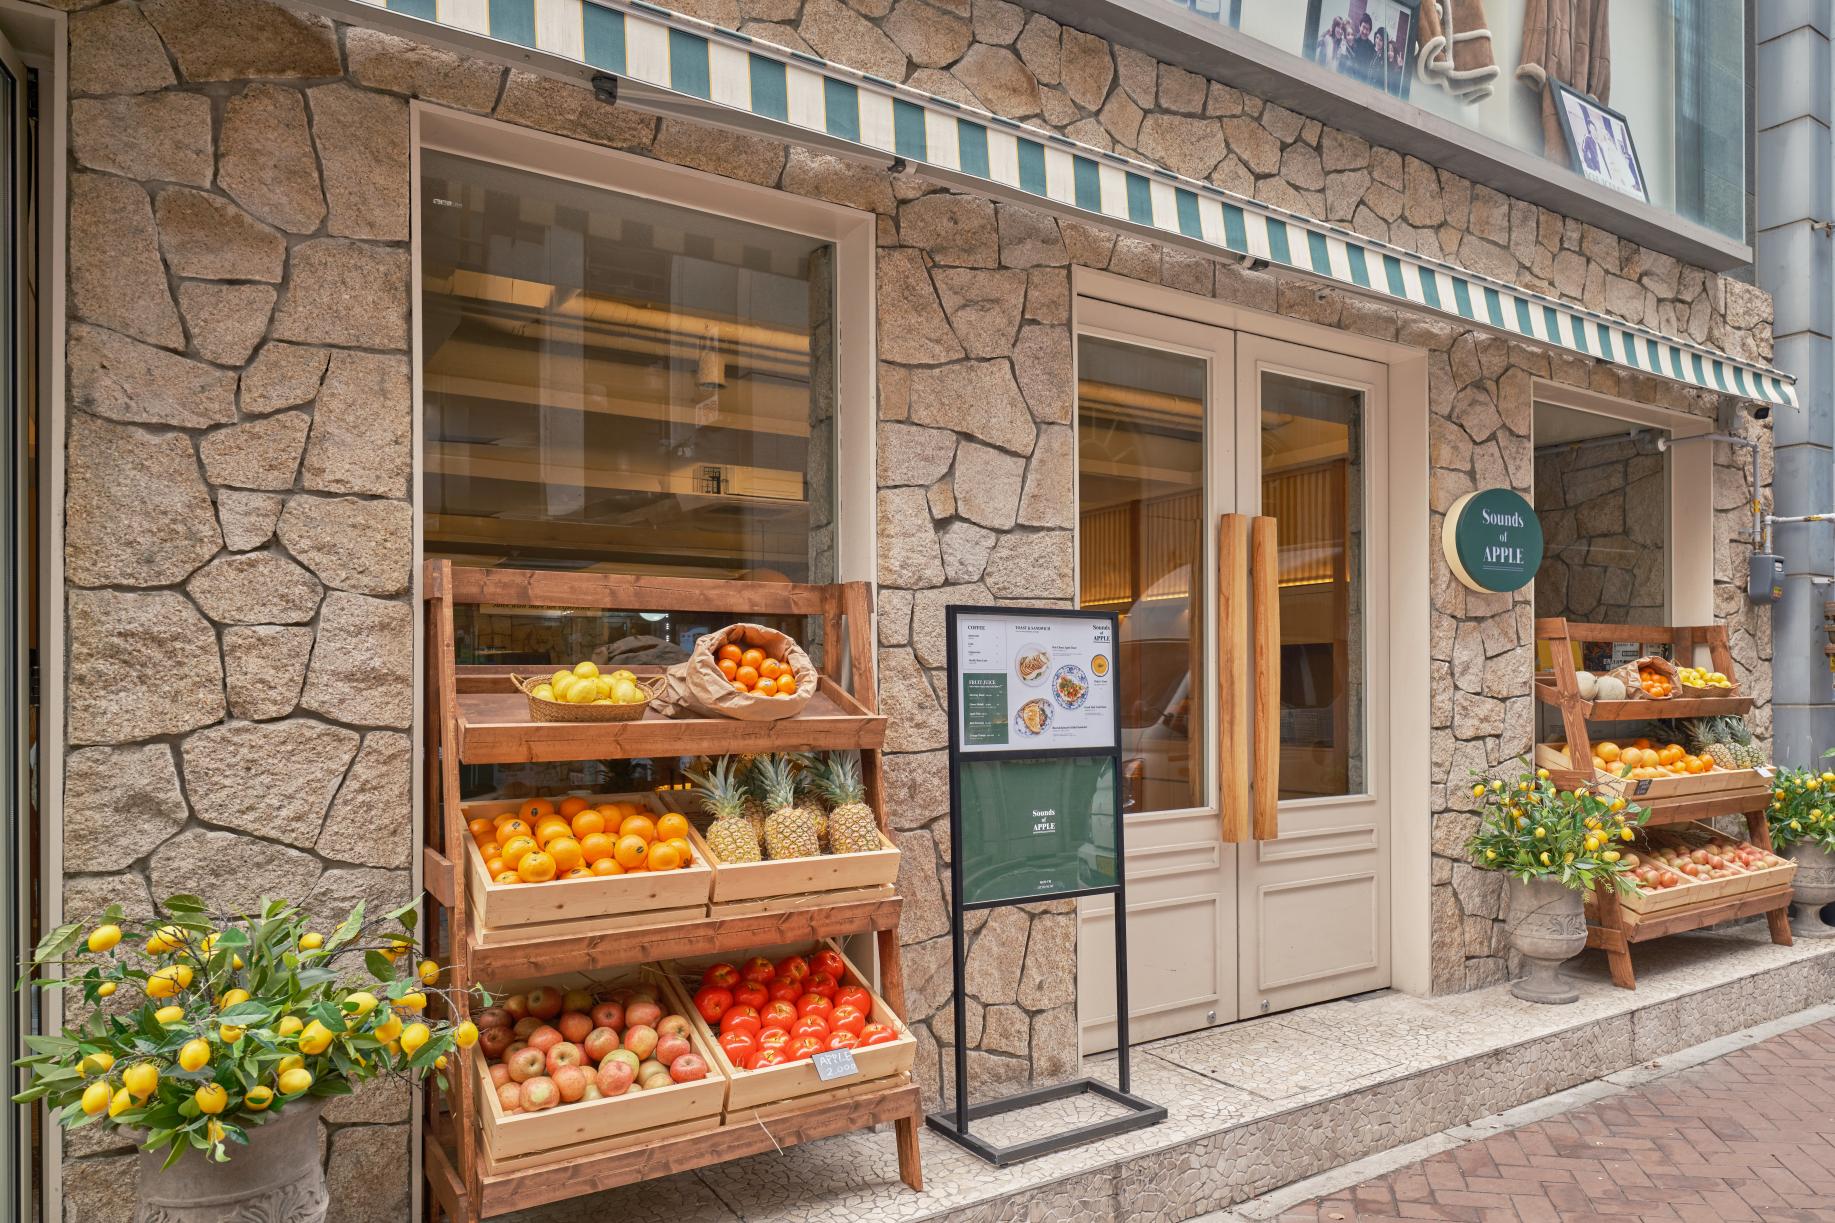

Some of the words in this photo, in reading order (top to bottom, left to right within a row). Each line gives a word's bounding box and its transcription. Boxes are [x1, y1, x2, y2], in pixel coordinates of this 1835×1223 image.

[1482, 508, 1524, 528] Sounds
[1499, 531, 1508, 543] of
[1483, 546, 1524, 564] APPLE
[1033, 823, 1055, 831] APPLE
[820, 1052, 852, 1066] APPLE
